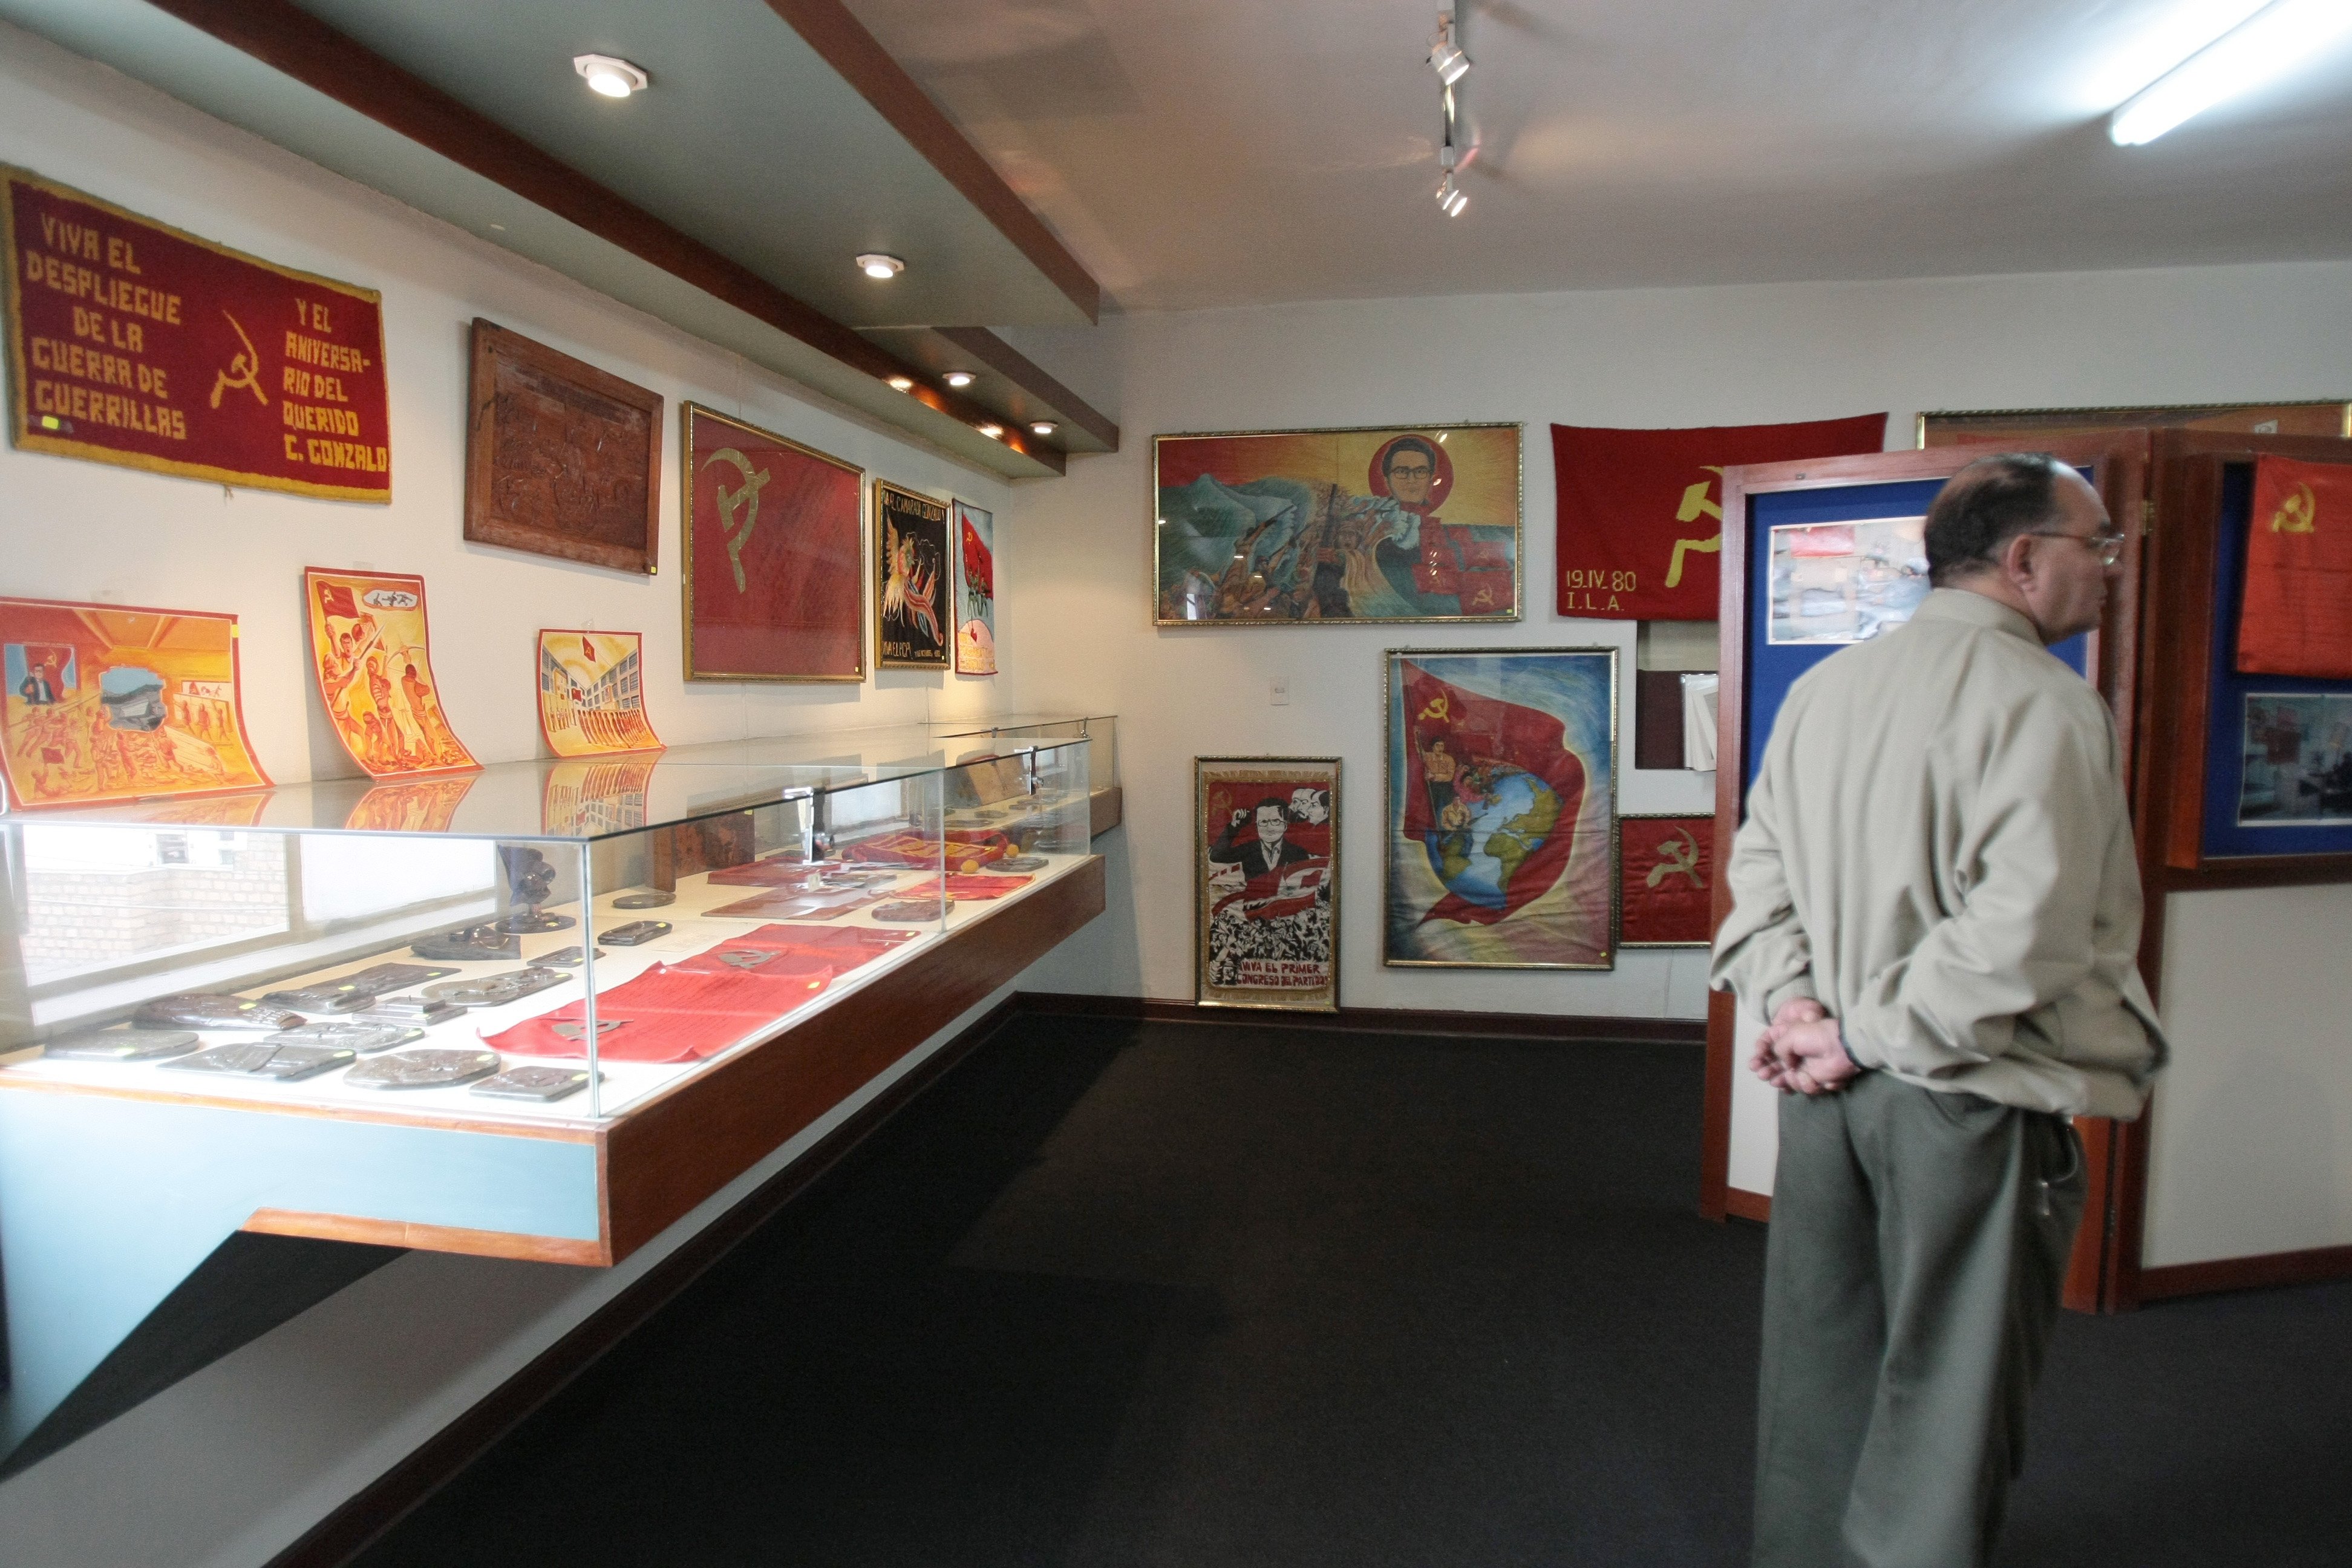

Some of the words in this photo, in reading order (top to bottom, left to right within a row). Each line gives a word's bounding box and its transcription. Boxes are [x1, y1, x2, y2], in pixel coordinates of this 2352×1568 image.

[41, 212, 100, 261] VIVA
[108, 237, 142, 275] EL
[27, 249, 181, 325] DESPLIEGUE
[73, 305, 105, 343] DE
[111, 319, 143, 353] LA
[295, 298, 306, 326] Y
[313, 302, 332, 333] EL
[32, 336, 133, 389] GUERRA
[137, 363, 168, 399] DE
[283, 365, 310, 397] RIO
[314, 374, 348, 402] DEL
[34, 380, 186, 440] GUERRILLAS
[283, 399, 359, 437] QUERIDO
[284, 433, 304, 462] C.
[307, 438, 388, 472] GONZALO
[1236, 973, 1279, 985] CONGRESO
[1265, 962, 1278, 973] EL
